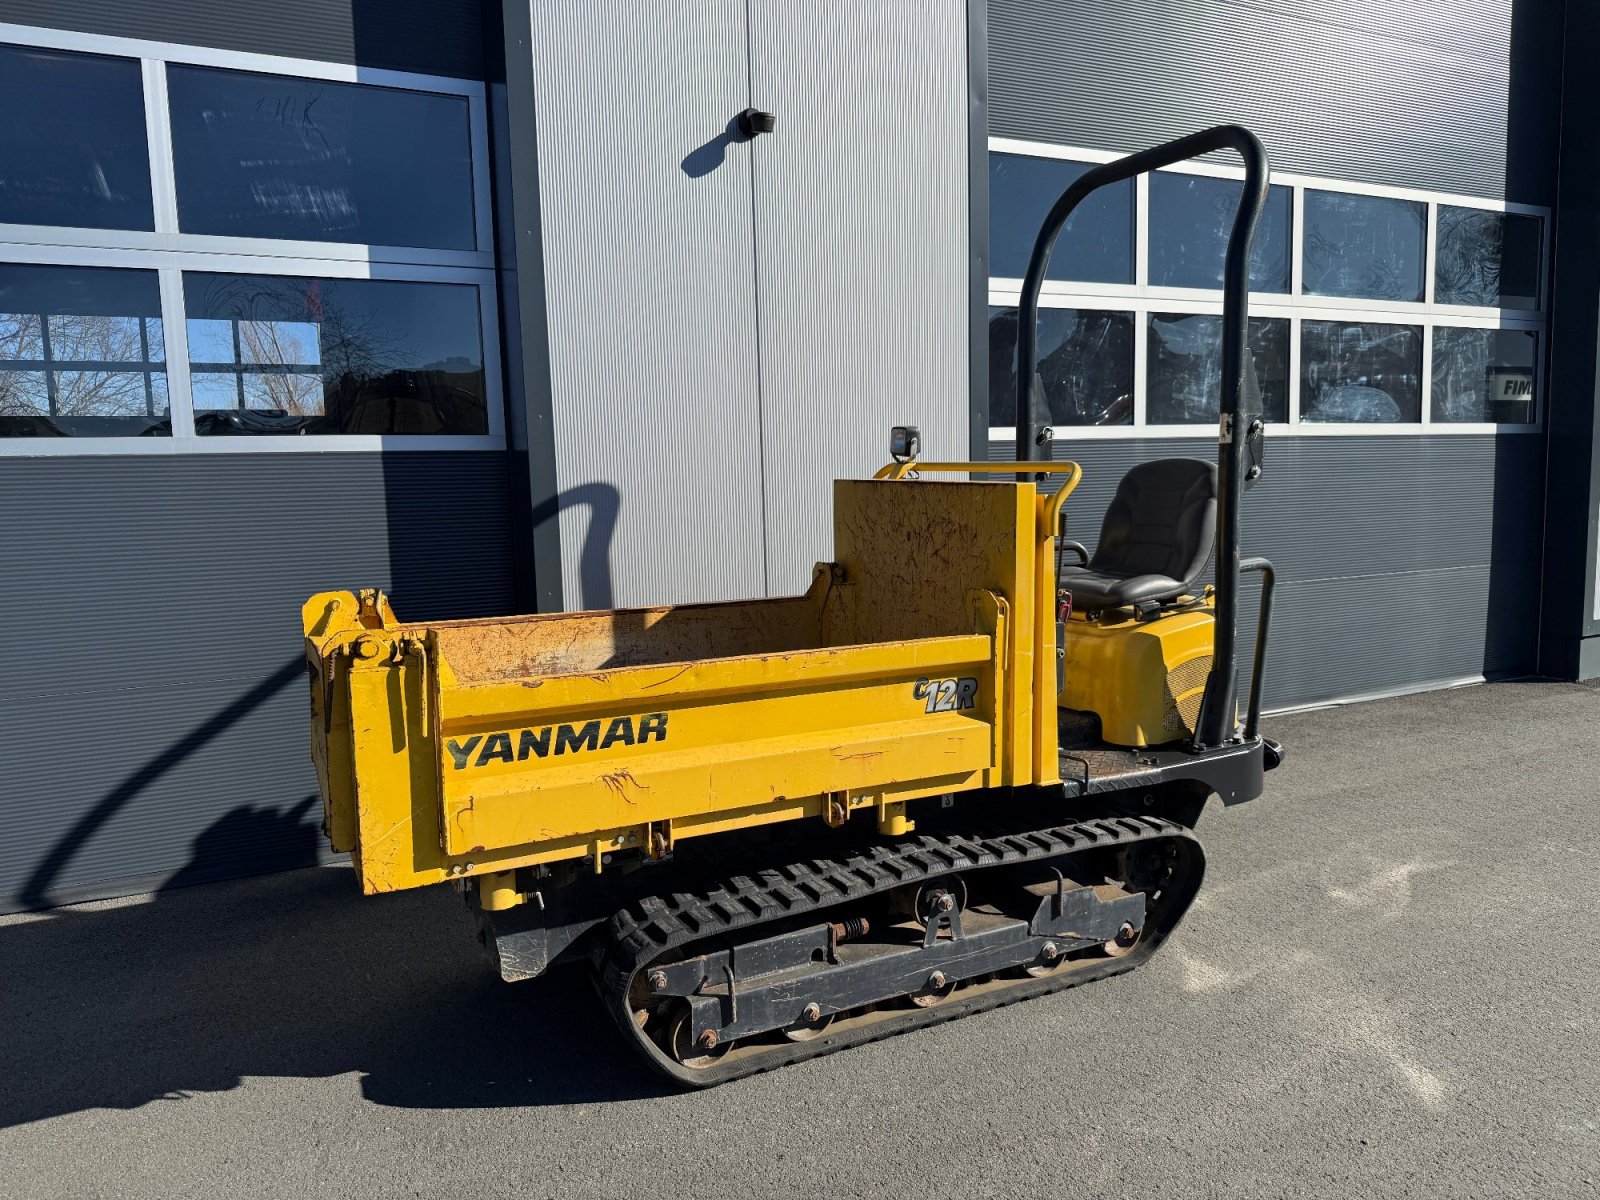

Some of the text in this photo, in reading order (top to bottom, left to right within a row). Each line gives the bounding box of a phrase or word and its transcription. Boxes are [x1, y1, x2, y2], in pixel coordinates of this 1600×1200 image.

[1503, 379, 1532, 395] FIM
[913, 677, 978, 714] C12R
[446, 712, 669, 770] YANMAR
